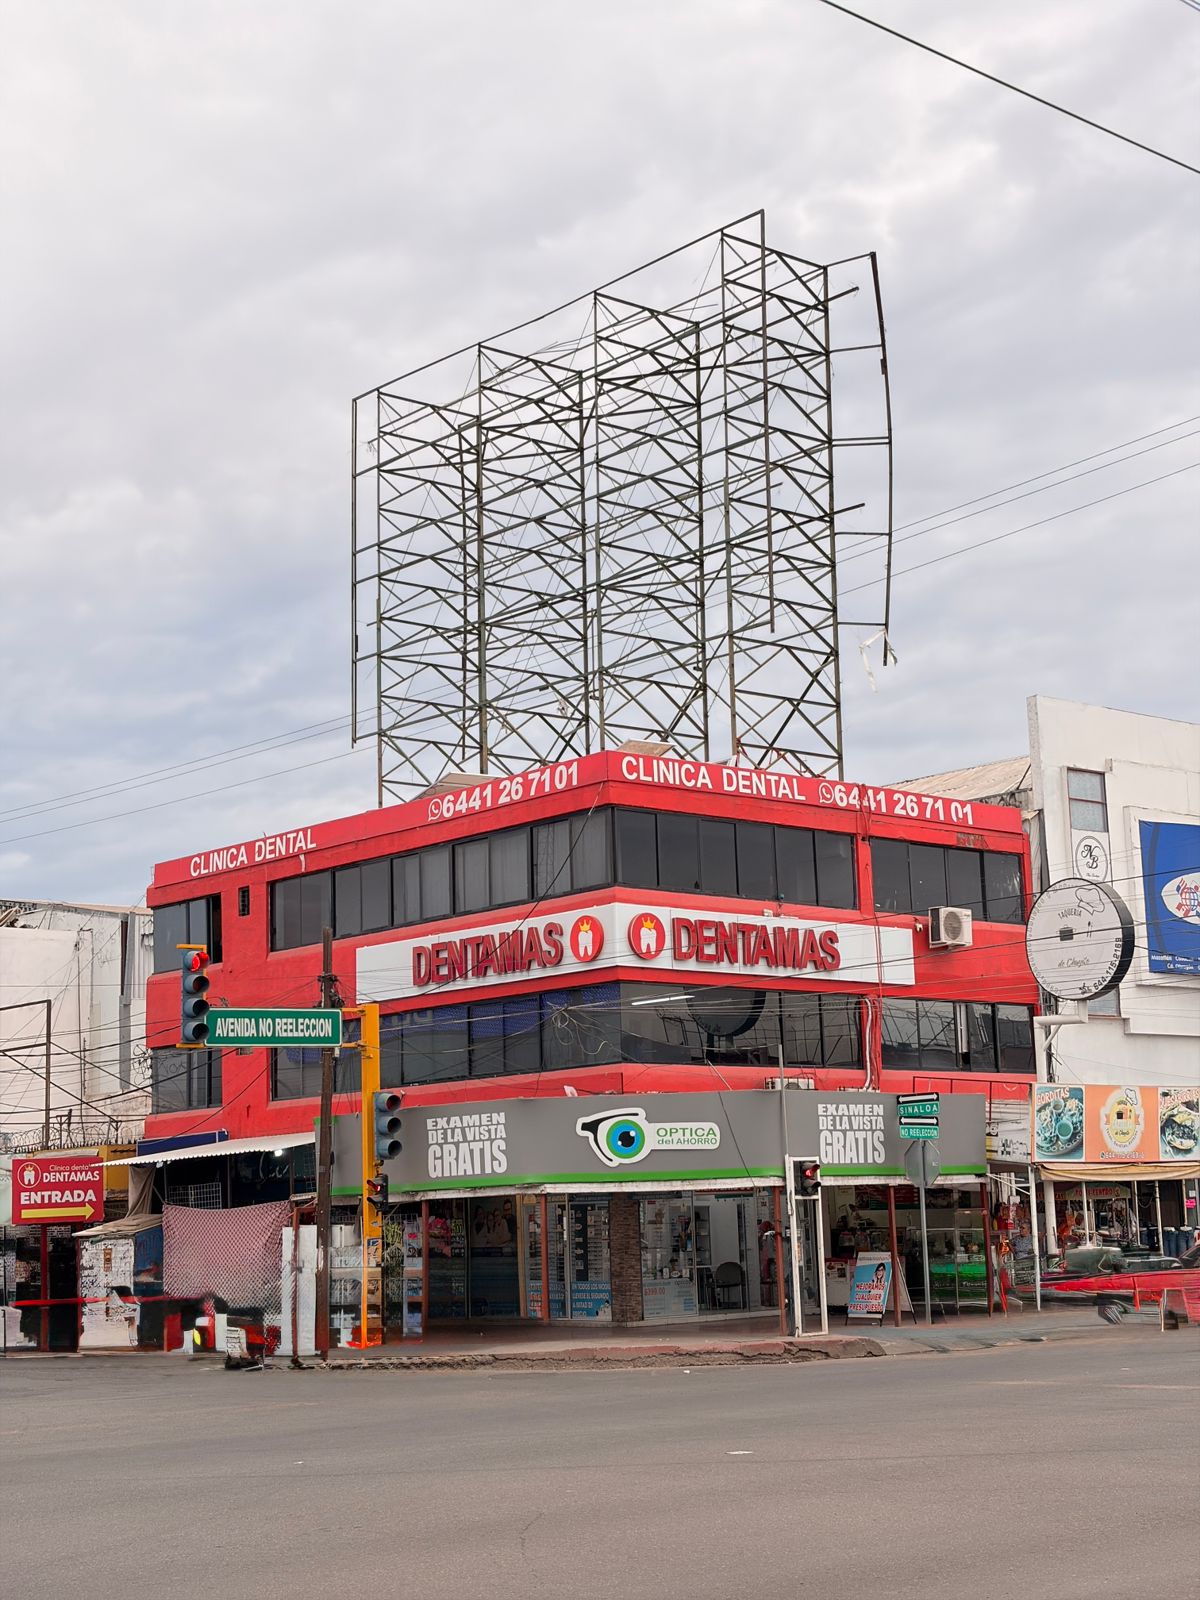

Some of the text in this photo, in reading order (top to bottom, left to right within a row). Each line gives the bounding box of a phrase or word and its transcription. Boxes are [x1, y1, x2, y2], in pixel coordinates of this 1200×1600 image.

[621, 755, 806, 801] CLINICA DENTAL
[442, 784, 492, 817] 6441
[498, 777, 523, 805] 26
[834, 785, 887, 813] 6441
[893, 793, 919, 817] 26
[190, 828, 317, 878] CLINICA DENTAL
[412, 921, 564, 986] DENTAMAS
[672, 917, 841, 971] DENTAMAS
[215, 1017, 332, 1037] AVENIDA NO REELECCION
[818, 1104, 884, 1115] EXAMEN
[899, 1103, 938, 1115] SINALOA
[426, 1112, 505, 1130] EXAMEN
[819, 1116, 884, 1129] DE LA VISTA
[428, 1124, 506, 1144] DE LA VISTA
[656, 1127, 717, 1137] OPTICA
[676, 1137, 717, 1145] AHORRO
[820, 1130, 885, 1164] GRATIS
[428, 1139, 508, 1178] GRATIS
[43, 1171, 100, 1182] DENTAMAS
[20, 1189, 97, 1204] ENTRADA
